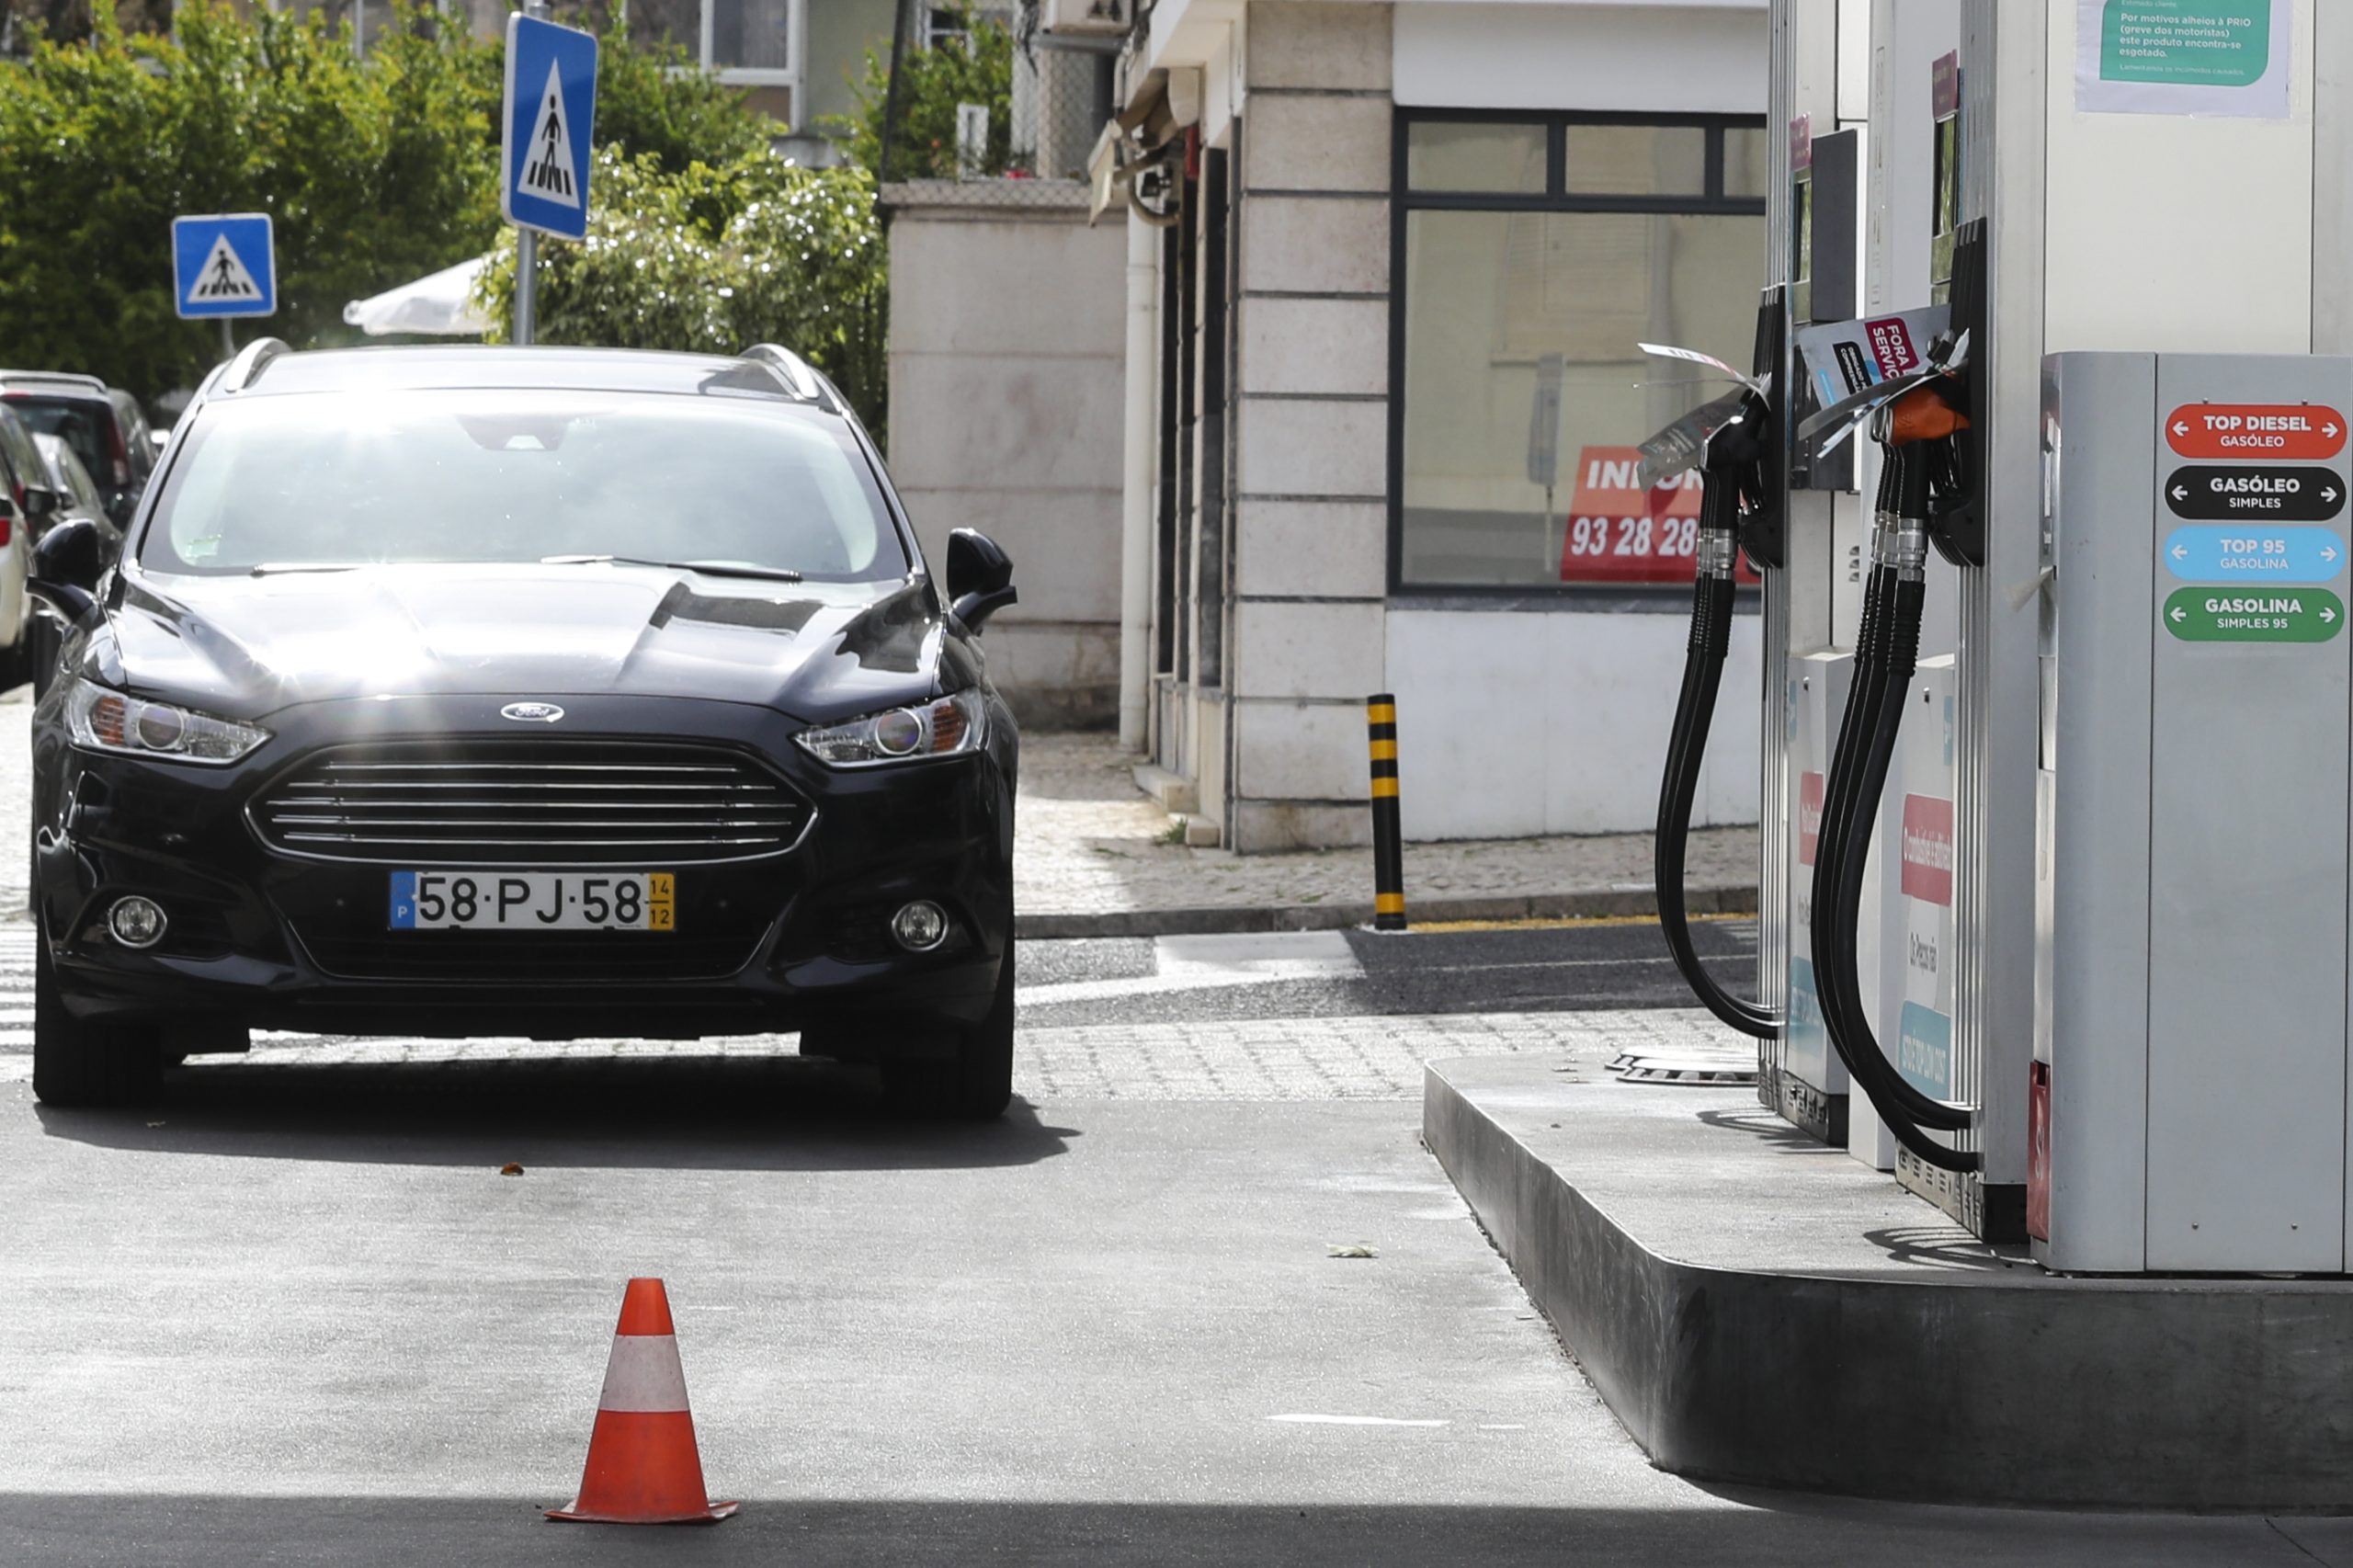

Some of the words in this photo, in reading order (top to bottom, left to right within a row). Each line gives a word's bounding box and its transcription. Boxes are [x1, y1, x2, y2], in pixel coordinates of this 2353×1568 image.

[2120, 13, 2138, 22] Por
[2140, 15, 2179, 24] motivos
[2181, 16, 2216, 26] alheios
[2226, 17, 2252, 28] PRIO
[2120, 25, 2153, 36] (greve
[2154, 26, 2172, 35] dos
[2175, 28, 2230, 38] motoristas)
[2120, 37, 2141, 45] este
[2143, 38, 2183, 48] produto
[2185, 40, 2242, 50] encontra-se
[2119, 48, 2168, 58] esgotado.
[1887, 324, 1910, 367] FORA
[1872, 326, 1900, 379] SERVIÇ
[2203, 415, 2242, 430] TOP
[2246, 416, 2312, 431] DIESEL
[2221, 434, 2285, 447] GASÓLEO
[2210, 475, 2301, 493] GASÓLEO
[2229, 498, 2281, 508] SIMPLES
[1571, 517, 1608, 555] 93
[1614, 517, 1653, 556] 28
[1658, 517, 1698, 557] 28
[2220, 540, 2257, 553] TOP
[2263, 540, 2285, 553] 95
[2221, 559, 2289, 569] GASOLINA
[2205, 598, 2302, 613] GASOLINA
[2217, 619, 2269, 629] SIMPLES
[2272, 619, 2288, 629] 95
[650, 880, 669, 894] 14
[397, 906, 408, 918] P
[650, 910, 669, 925] 12
